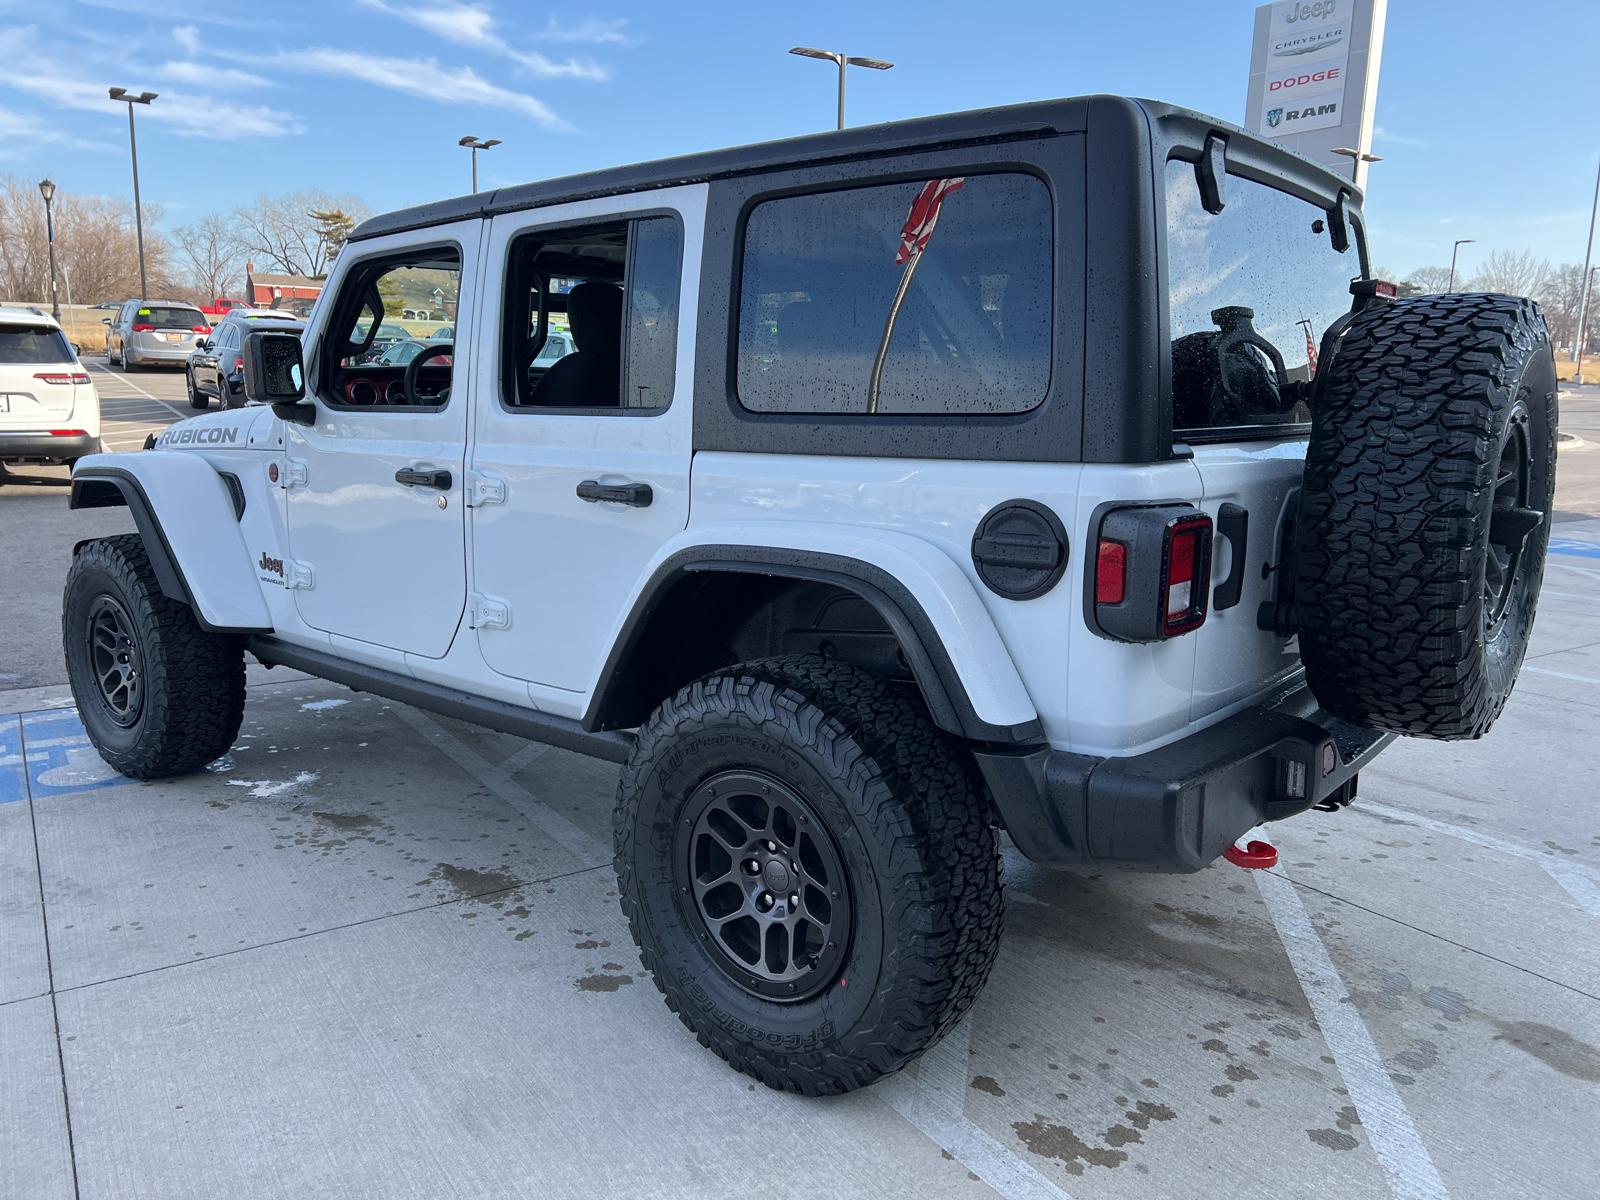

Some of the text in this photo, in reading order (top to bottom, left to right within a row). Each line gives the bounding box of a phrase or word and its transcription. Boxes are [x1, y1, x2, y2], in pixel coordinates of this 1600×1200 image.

[1286, 0, 1336, 23] Jeep
[1275, 29, 1343, 49] CHRYSLER
[1269, 68, 1341, 91] DODGE
[1286, 103, 1337, 121] RAM
[160, 427, 239, 445] RUBICON
[259, 552, 284, 577] Jeep
